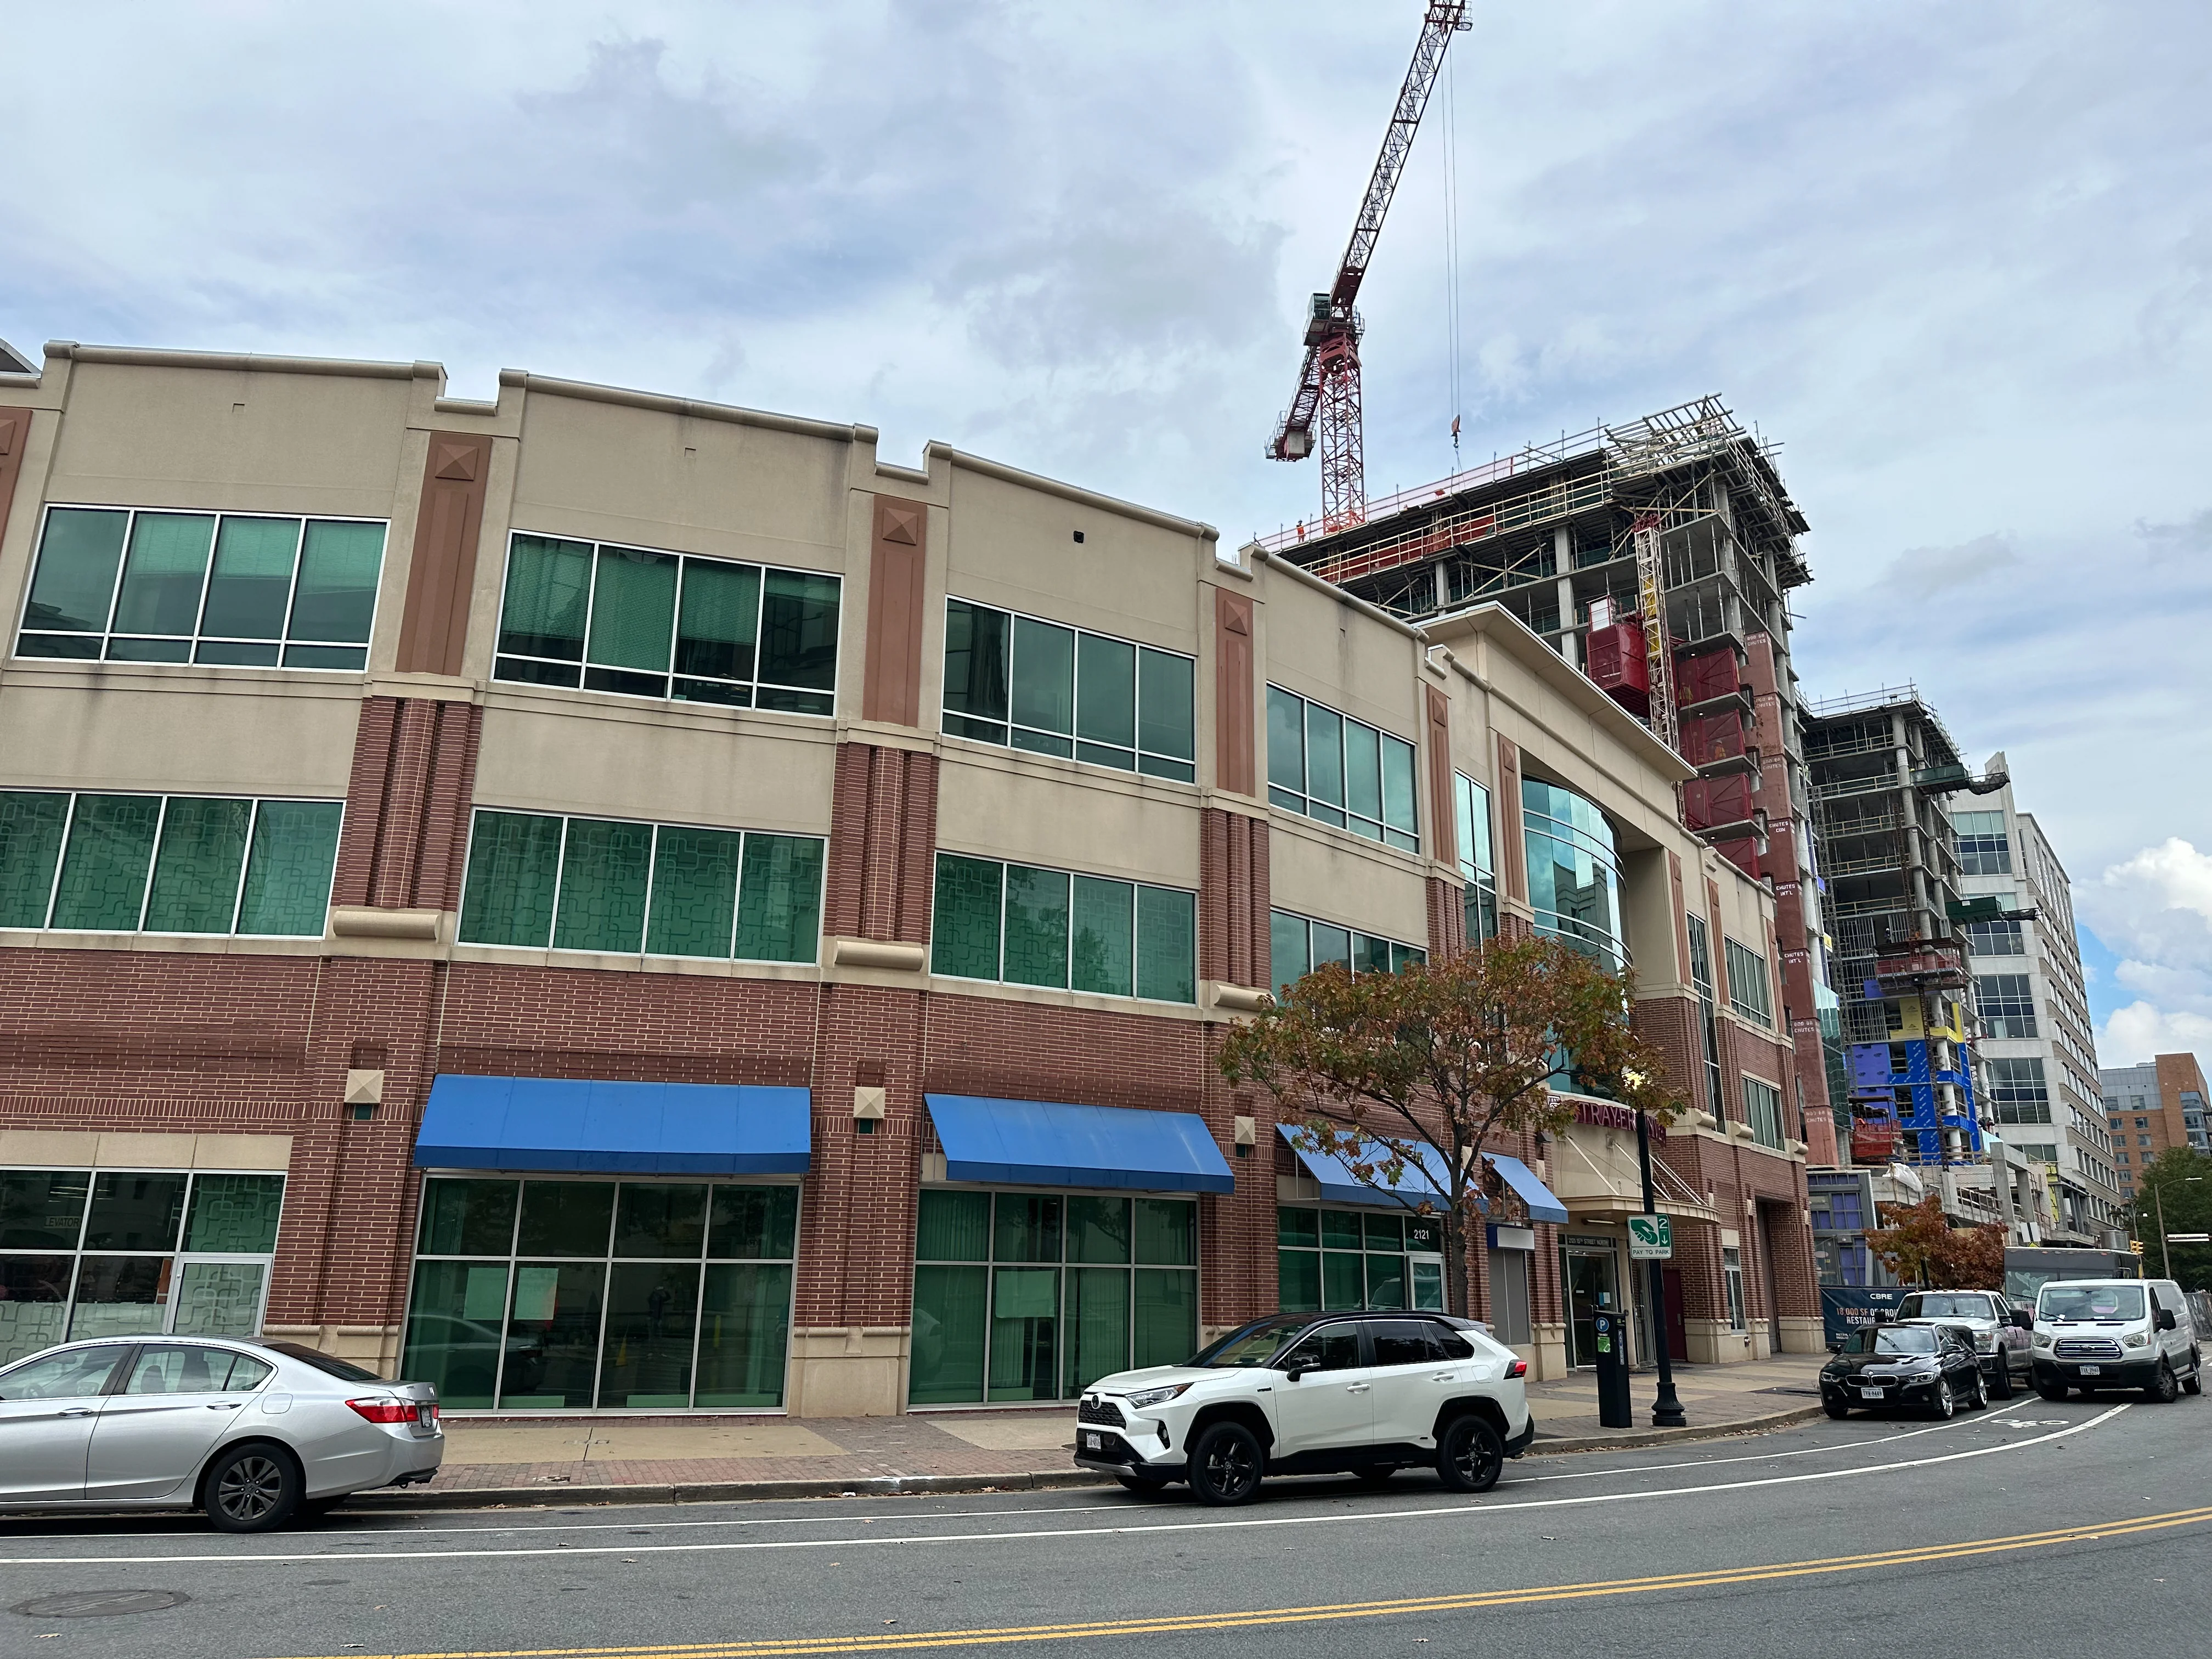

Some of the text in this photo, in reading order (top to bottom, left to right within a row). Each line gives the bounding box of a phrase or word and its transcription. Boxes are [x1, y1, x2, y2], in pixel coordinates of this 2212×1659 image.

[1658, 1218, 1668, 1229] 2
[1414, 1229, 1429, 1240] 2121
[1860, 1308, 1868, 1316] SF
[1599, 1319, 1606, 1329] P
